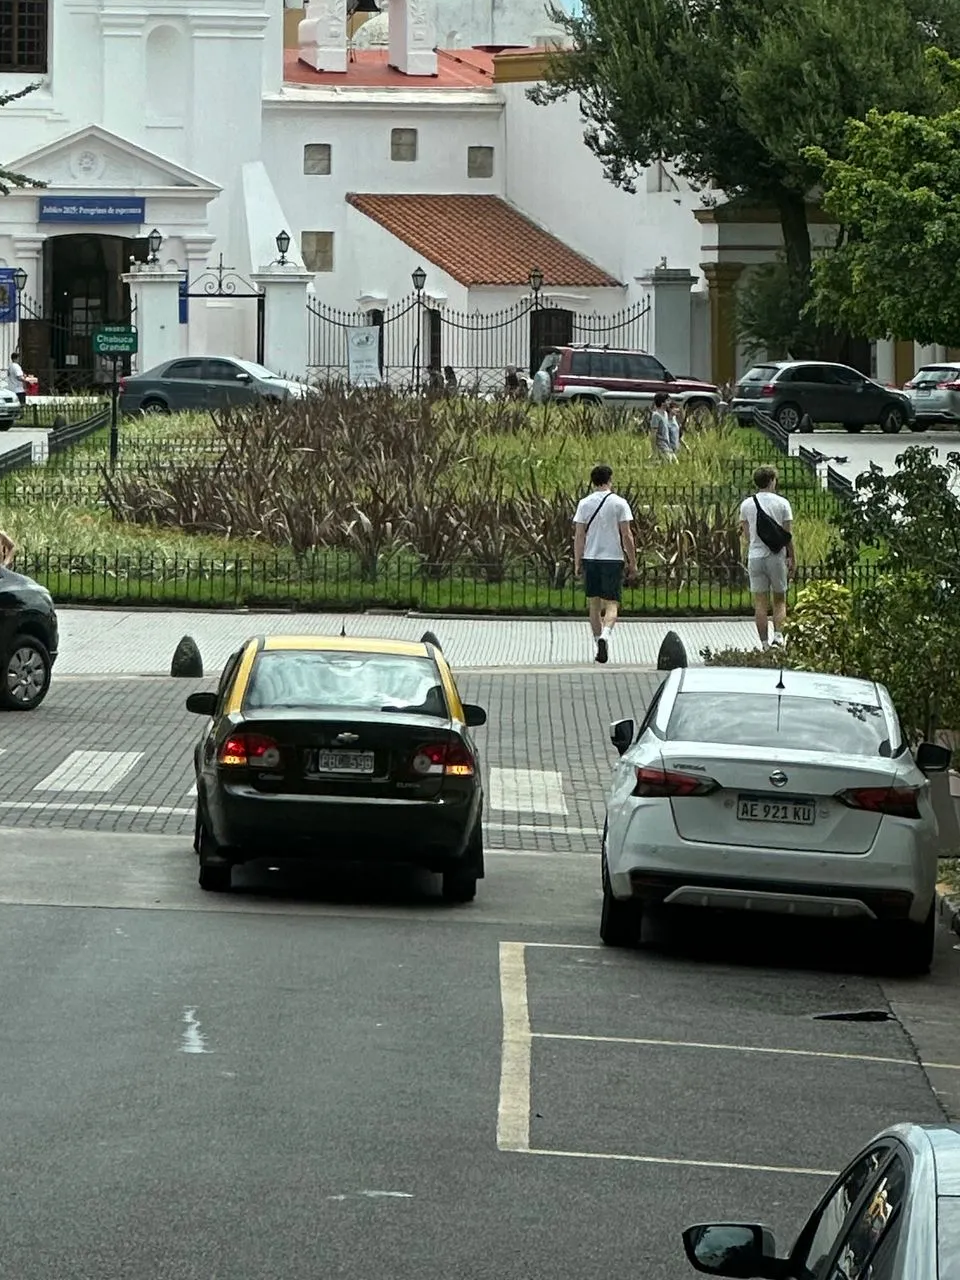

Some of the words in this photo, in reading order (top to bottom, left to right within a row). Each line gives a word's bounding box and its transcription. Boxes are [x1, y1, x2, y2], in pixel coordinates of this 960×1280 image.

[97, 334, 134, 343] Chabuca
[99, 343, 130, 351] Granda
[741, 802, 758, 817] AE
[763, 804, 788, 819] 921
[793, 807, 811, 821] KU
